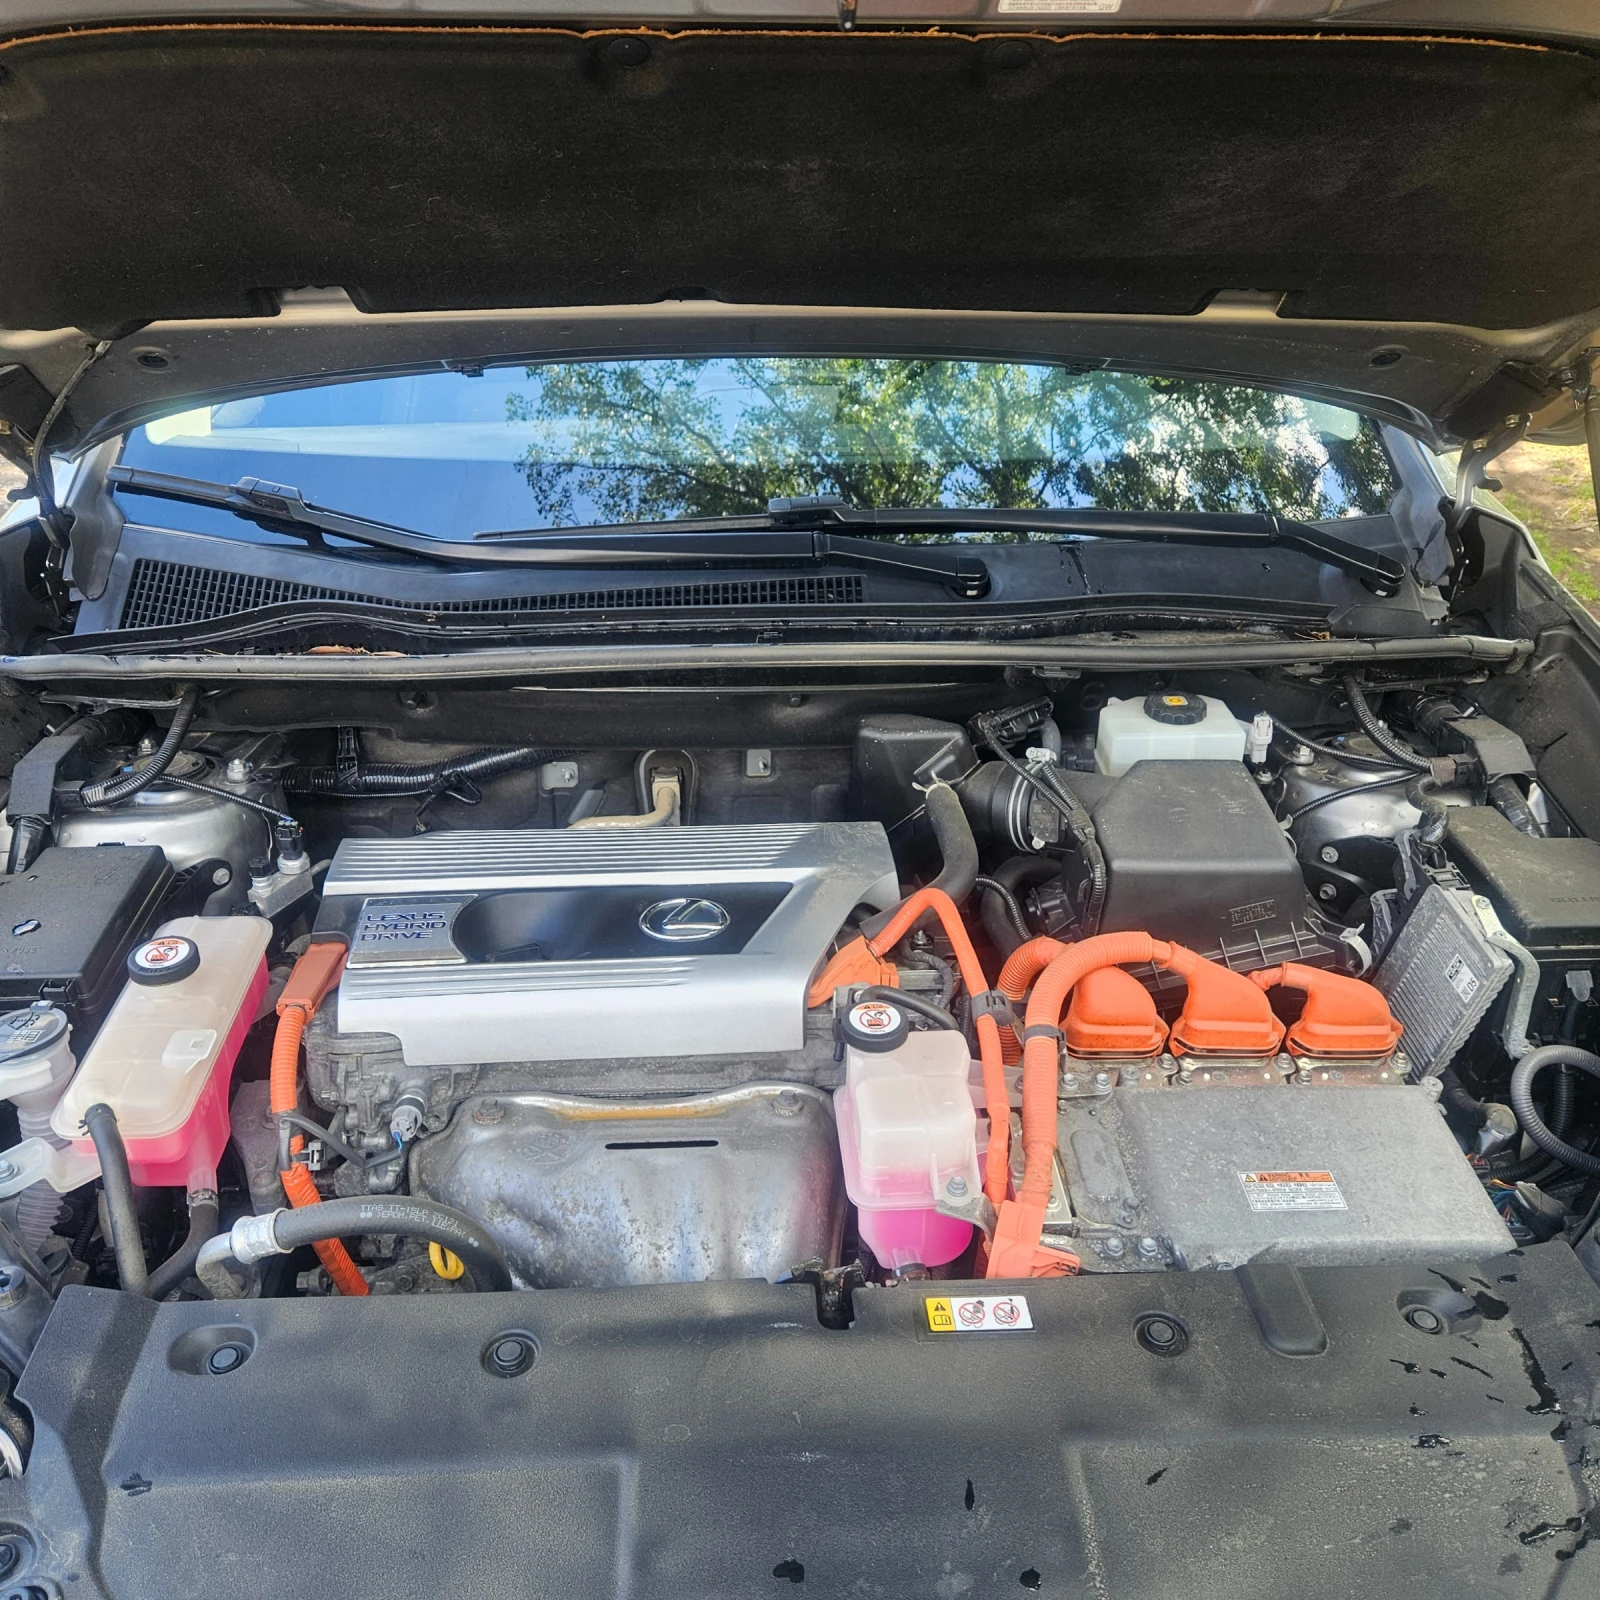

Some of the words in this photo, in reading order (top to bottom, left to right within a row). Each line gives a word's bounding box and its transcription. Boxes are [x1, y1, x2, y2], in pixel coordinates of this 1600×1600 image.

[367, 911, 445, 922] LEXUS
[364, 920, 448, 931] HYBRID
[361, 930, 433, 941] DRIVE
